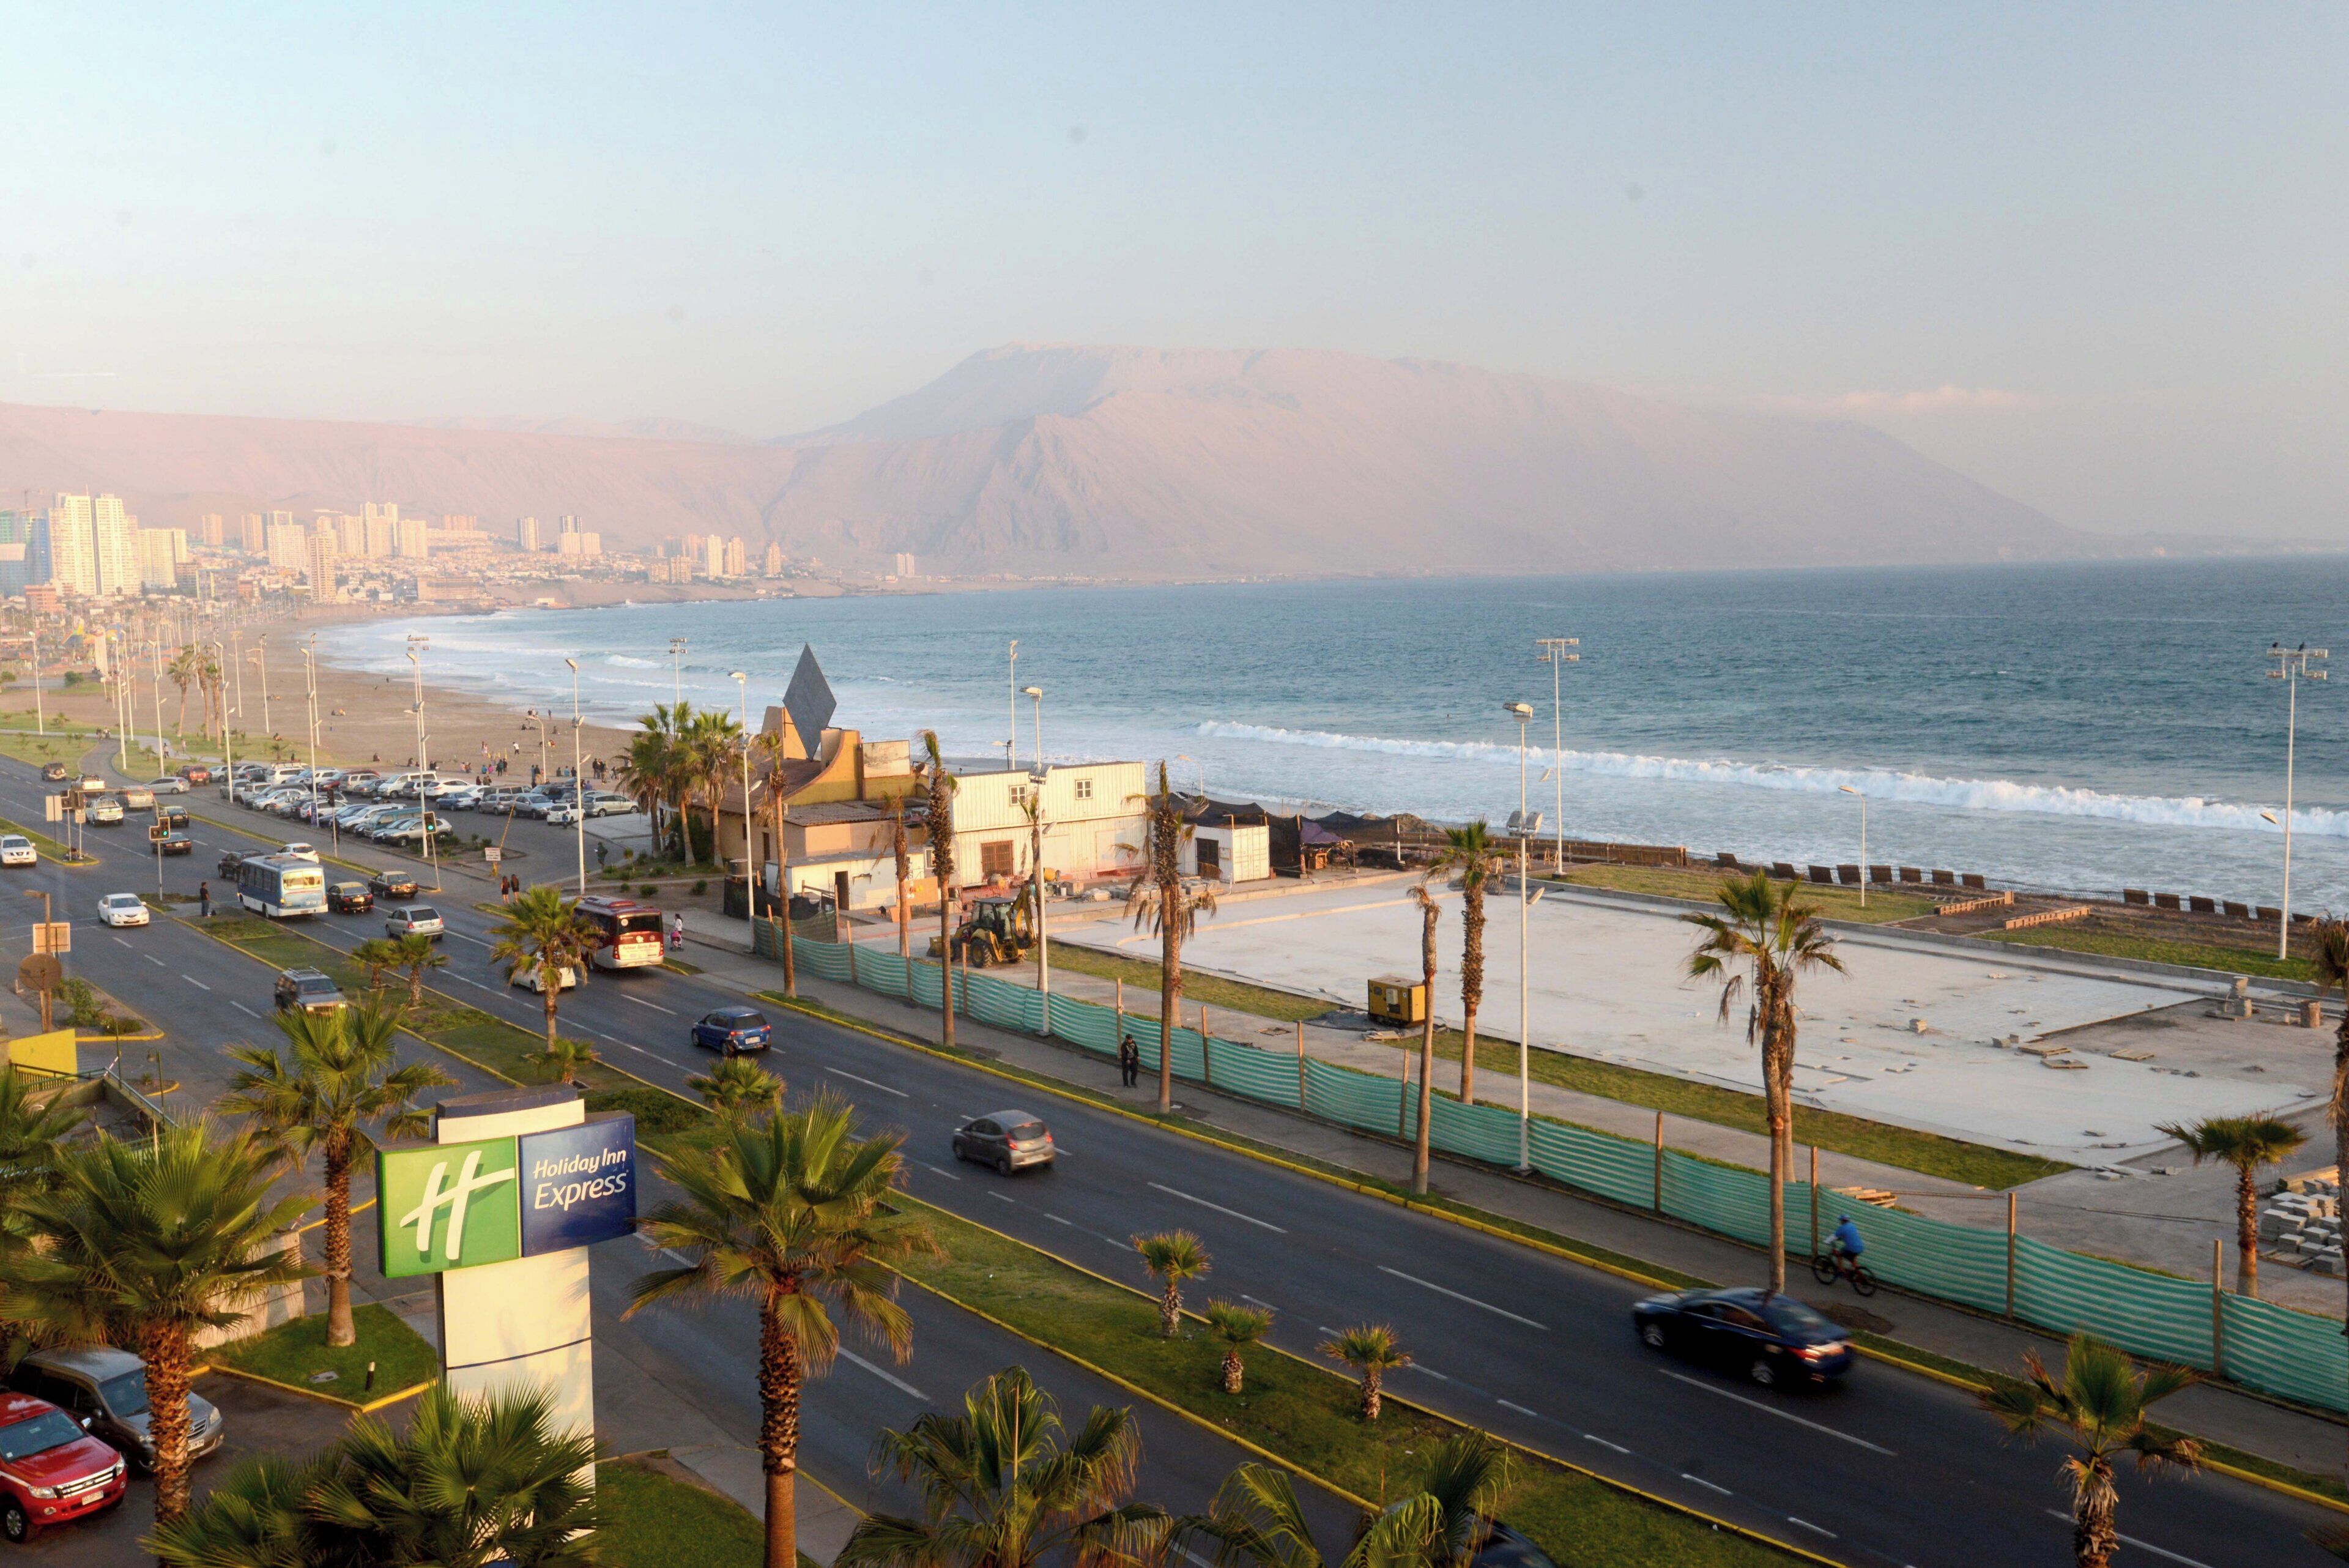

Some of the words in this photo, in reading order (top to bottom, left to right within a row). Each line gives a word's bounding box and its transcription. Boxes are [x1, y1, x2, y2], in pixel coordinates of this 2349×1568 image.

[533, 1154, 600, 1180] Holiday
[601, 1148, 626, 1167] Inn
[534, 1173, 627, 1211] Express
